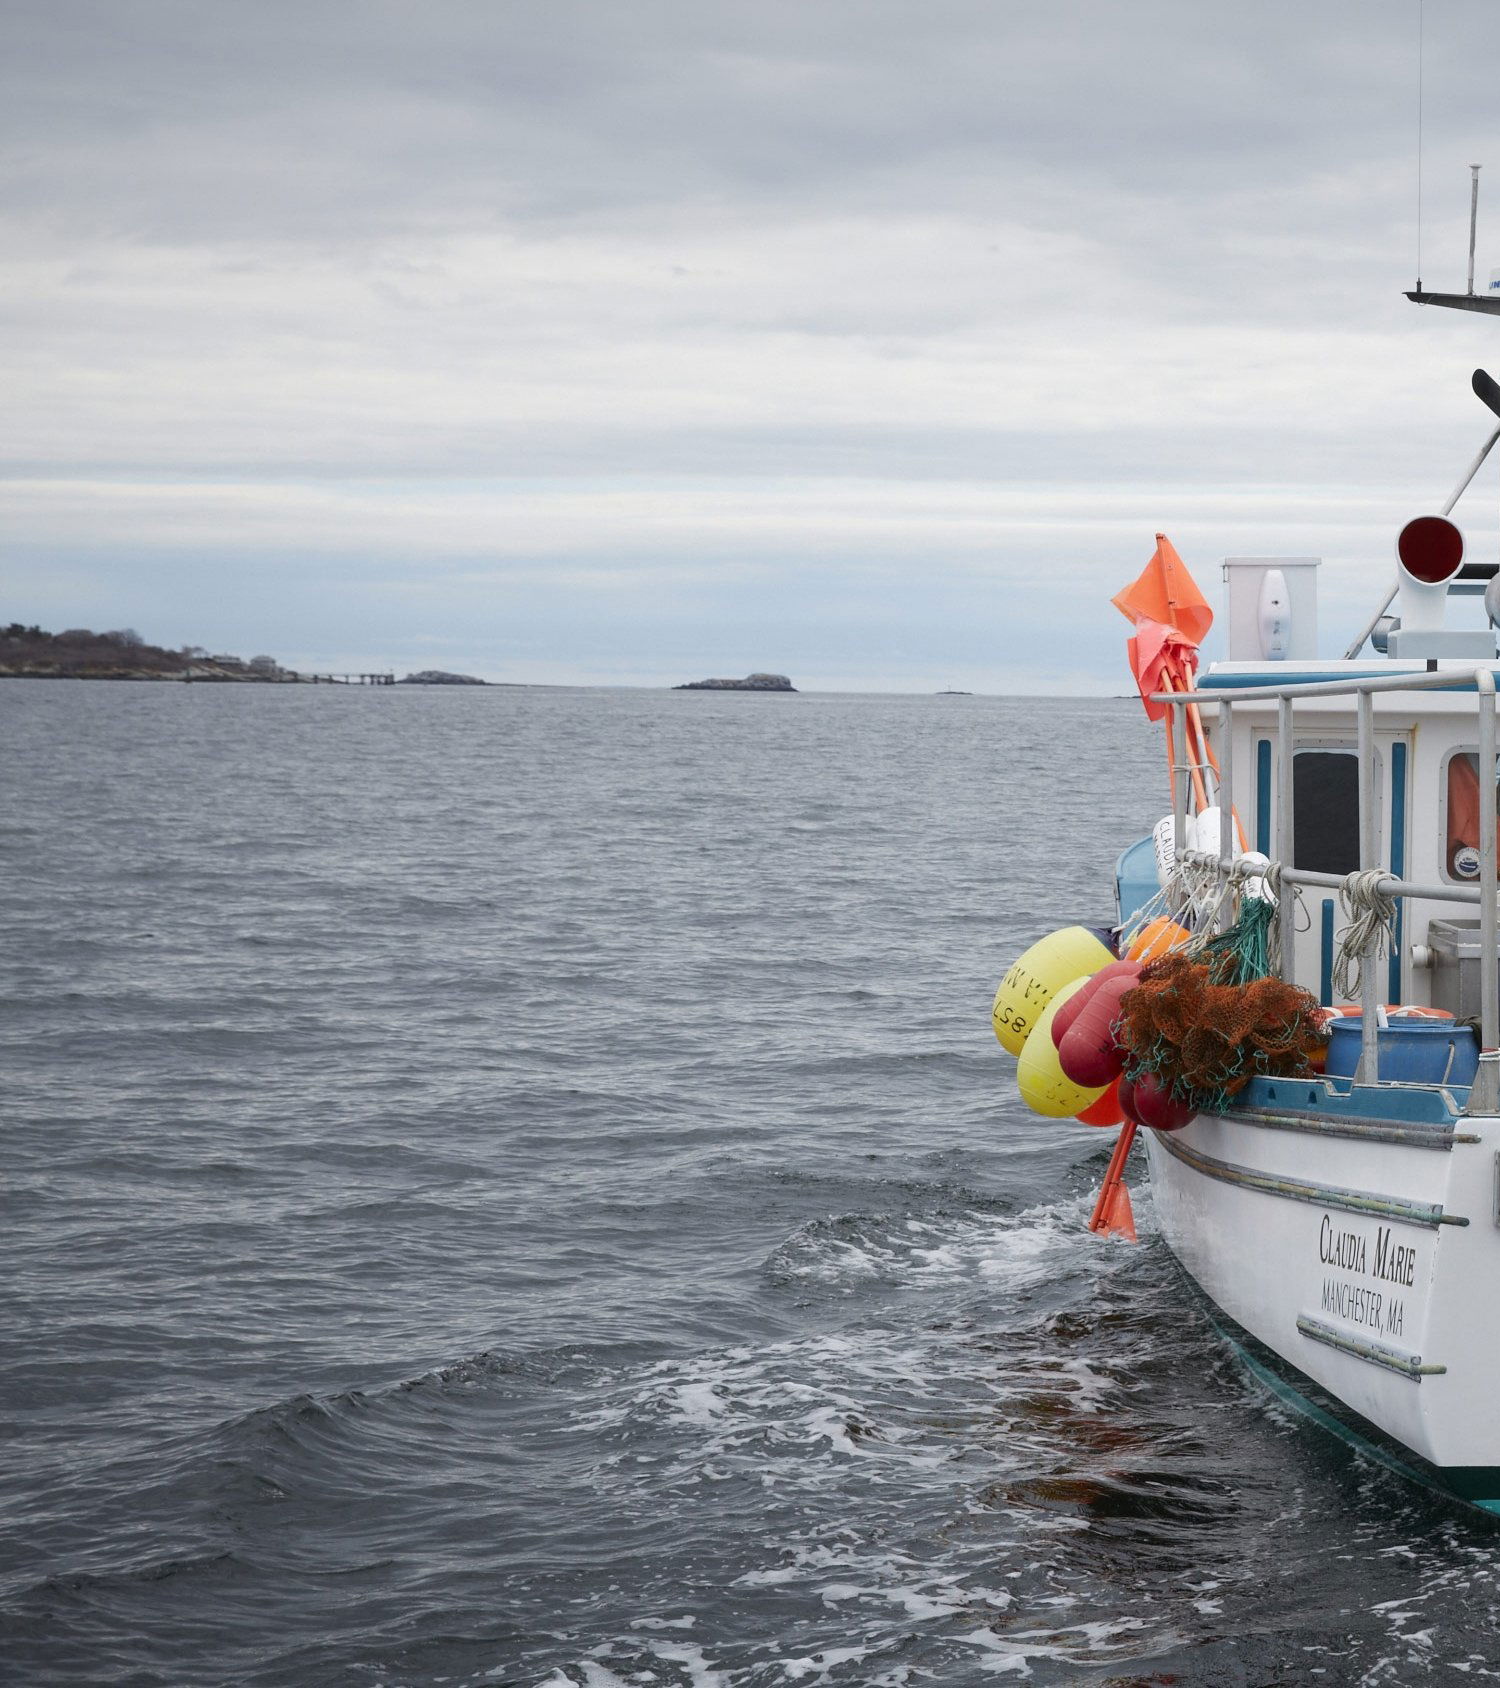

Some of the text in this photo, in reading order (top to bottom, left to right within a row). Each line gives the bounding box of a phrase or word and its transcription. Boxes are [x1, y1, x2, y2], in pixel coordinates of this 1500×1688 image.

[1319, 1214, 1416, 1287] CLAUDIA MARIE
[1321, 1277, 1404, 1338] MANCHESTER, MA
